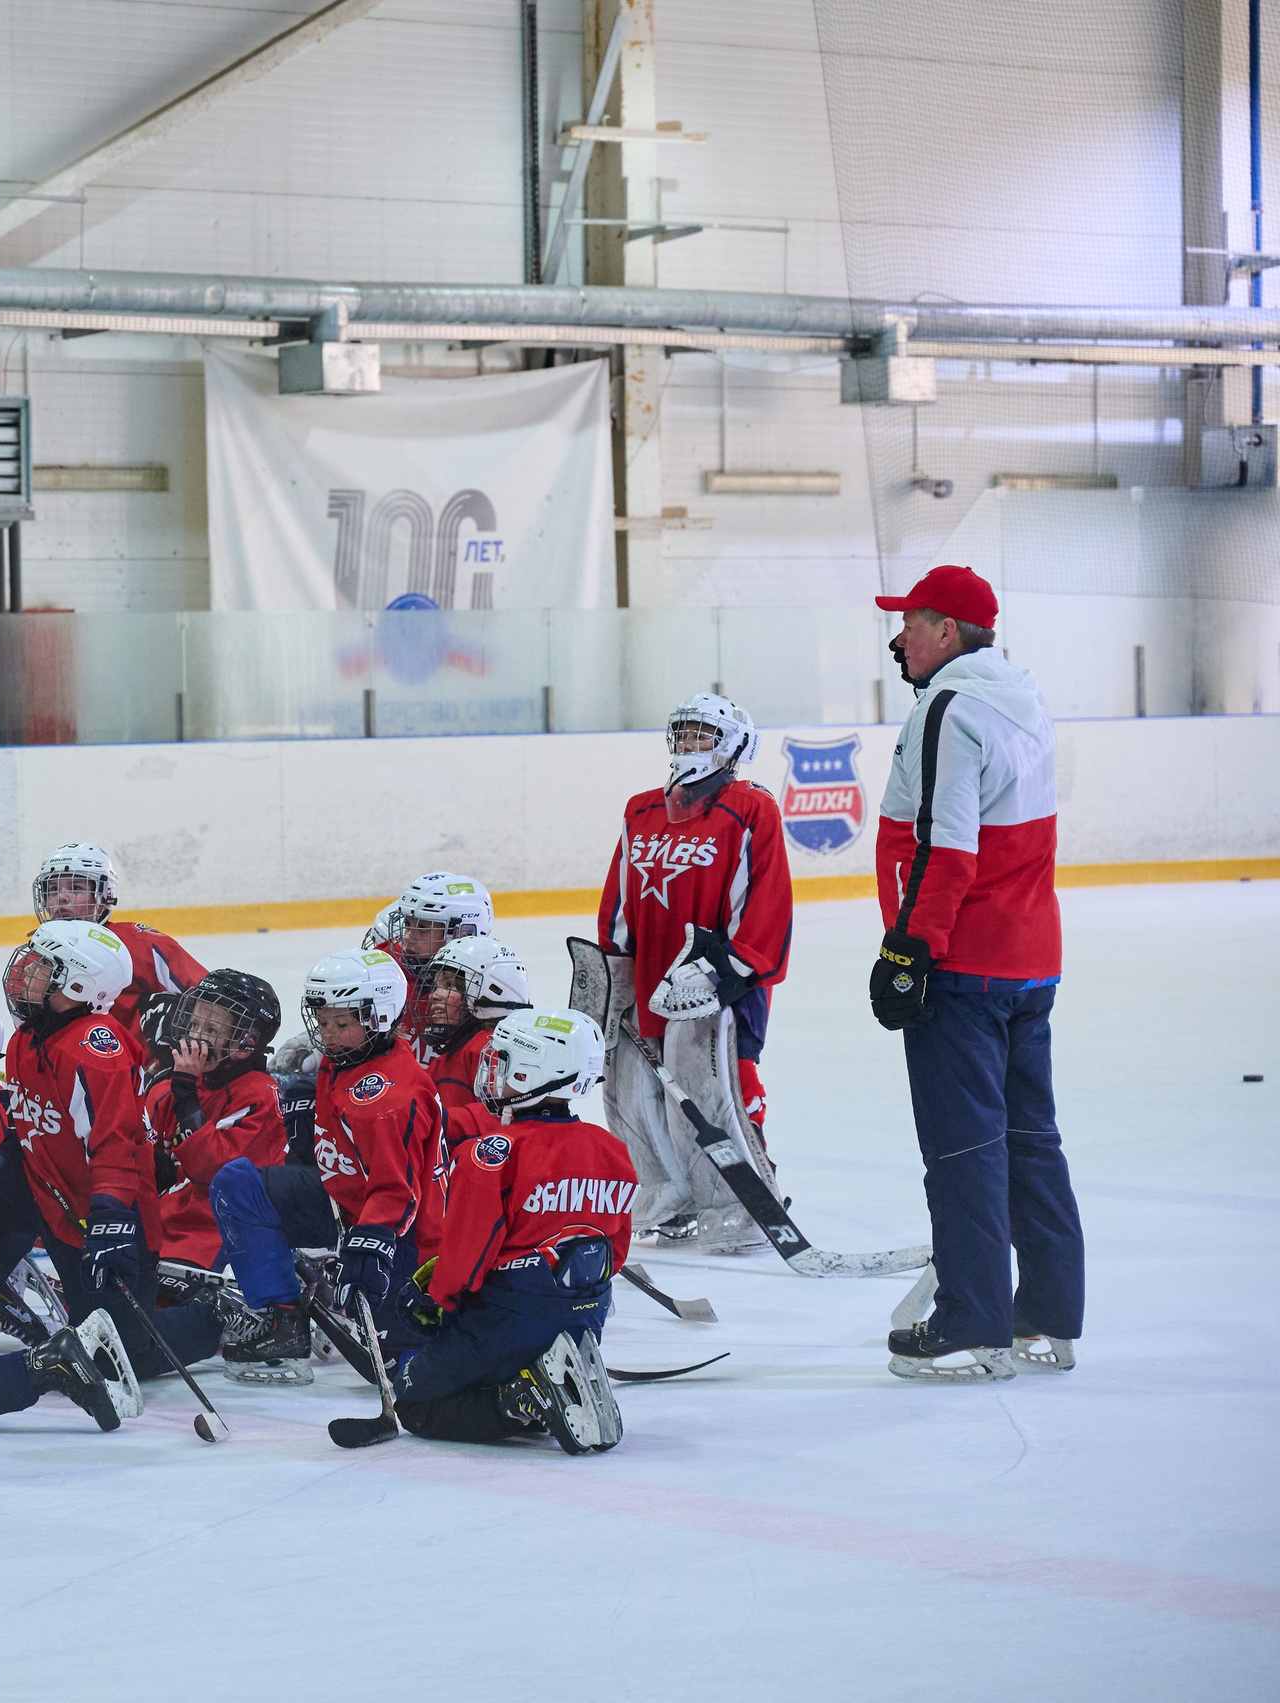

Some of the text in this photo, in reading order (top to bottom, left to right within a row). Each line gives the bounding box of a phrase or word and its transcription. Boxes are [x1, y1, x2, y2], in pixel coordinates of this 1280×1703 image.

[634, 833, 716, 844] BOSTON
[70, 959, 87, 969] CCM
[260, 1008, 274, 1019] CCM
[93, 1030, 110, 1039] 10
[513, 1038, 538, 1051] BAUER
[362, 1076, 379, 1086] 10
[510, 1092, 532, 1103] BAUER
[489, 1136, 507, 1149] 10
[479, 1144, 505, 1161] STEPS
